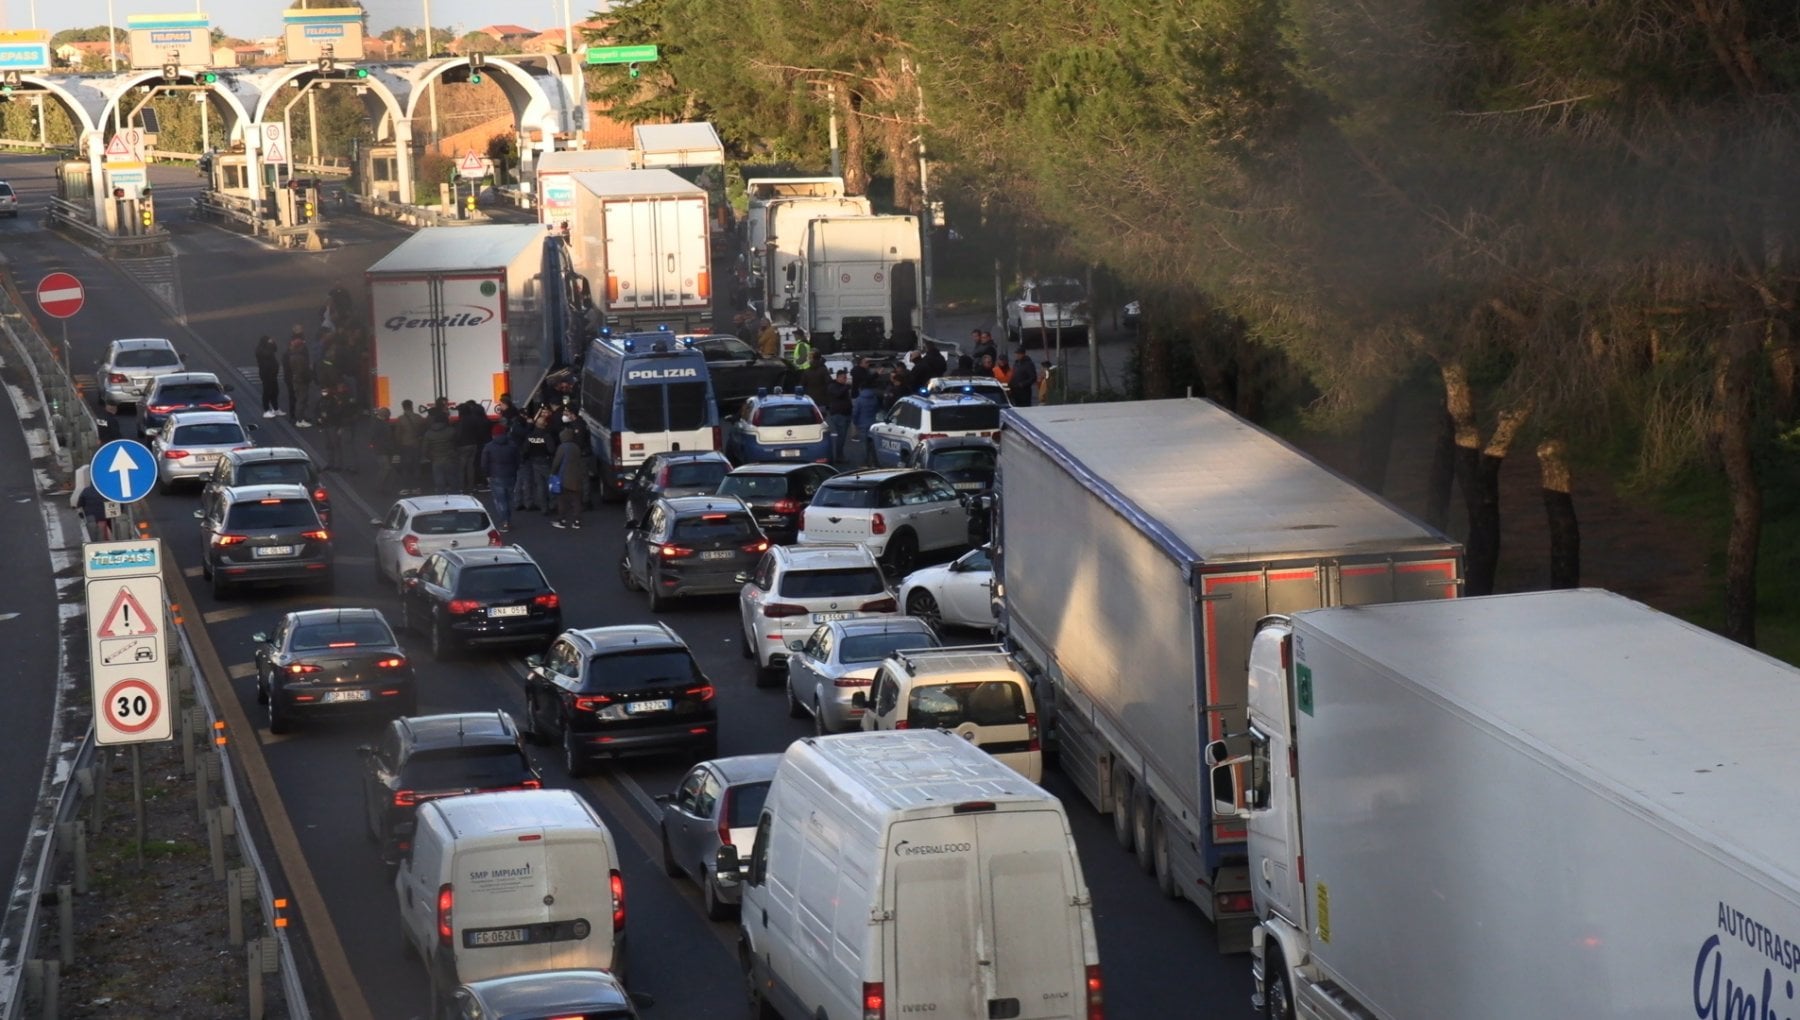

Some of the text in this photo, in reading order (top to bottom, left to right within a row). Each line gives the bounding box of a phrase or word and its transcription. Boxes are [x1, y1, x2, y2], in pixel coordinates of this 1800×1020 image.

[151, 32, 190, 41] TELEPASS
[473, 53, 480, 65] 1
[165, 65, 177, 78] 3
[321, 60, 332, 72] 2
[6, 71, 18, 84] 4
[384, 313, 483, 333] Gentile
[628, 368, 697, 380] POLIZIA
[117, 695, 147, 717] 30
[470, 870, 489, 880] SMP
[902, 1002, 937, 1013] IVECO
